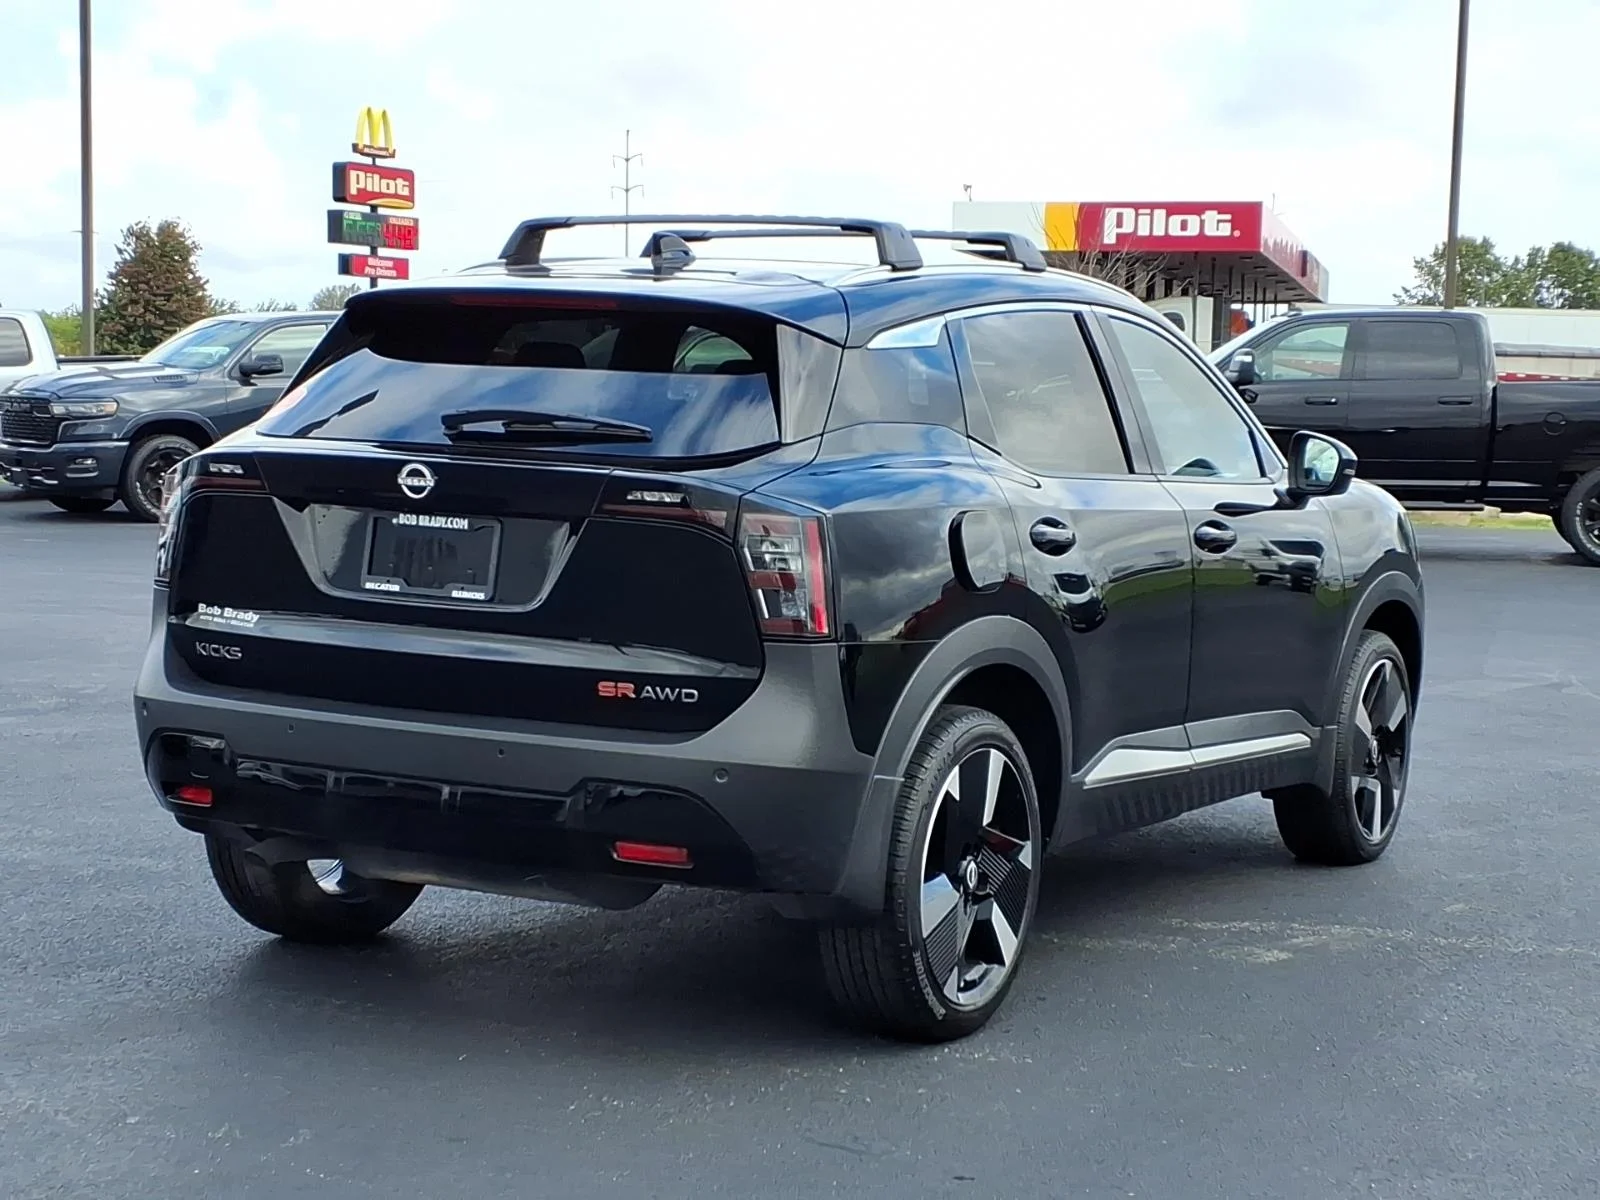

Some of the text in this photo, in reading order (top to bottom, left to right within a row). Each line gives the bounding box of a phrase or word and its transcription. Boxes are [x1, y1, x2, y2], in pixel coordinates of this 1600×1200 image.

[349, 169, 410, 196] Pilot
[1103, 207, 1232, 244] Pilot
[398, 477, 434, 487] NISSAN
[399, 513, 469, 530] BOB BRADY.COM
[198, 603, 222, 615] Bob
[223, 607, 260, 623] Brady
[195, 641, 242, 659] KICKS
[598, 681, 699, 702] SR AWD
